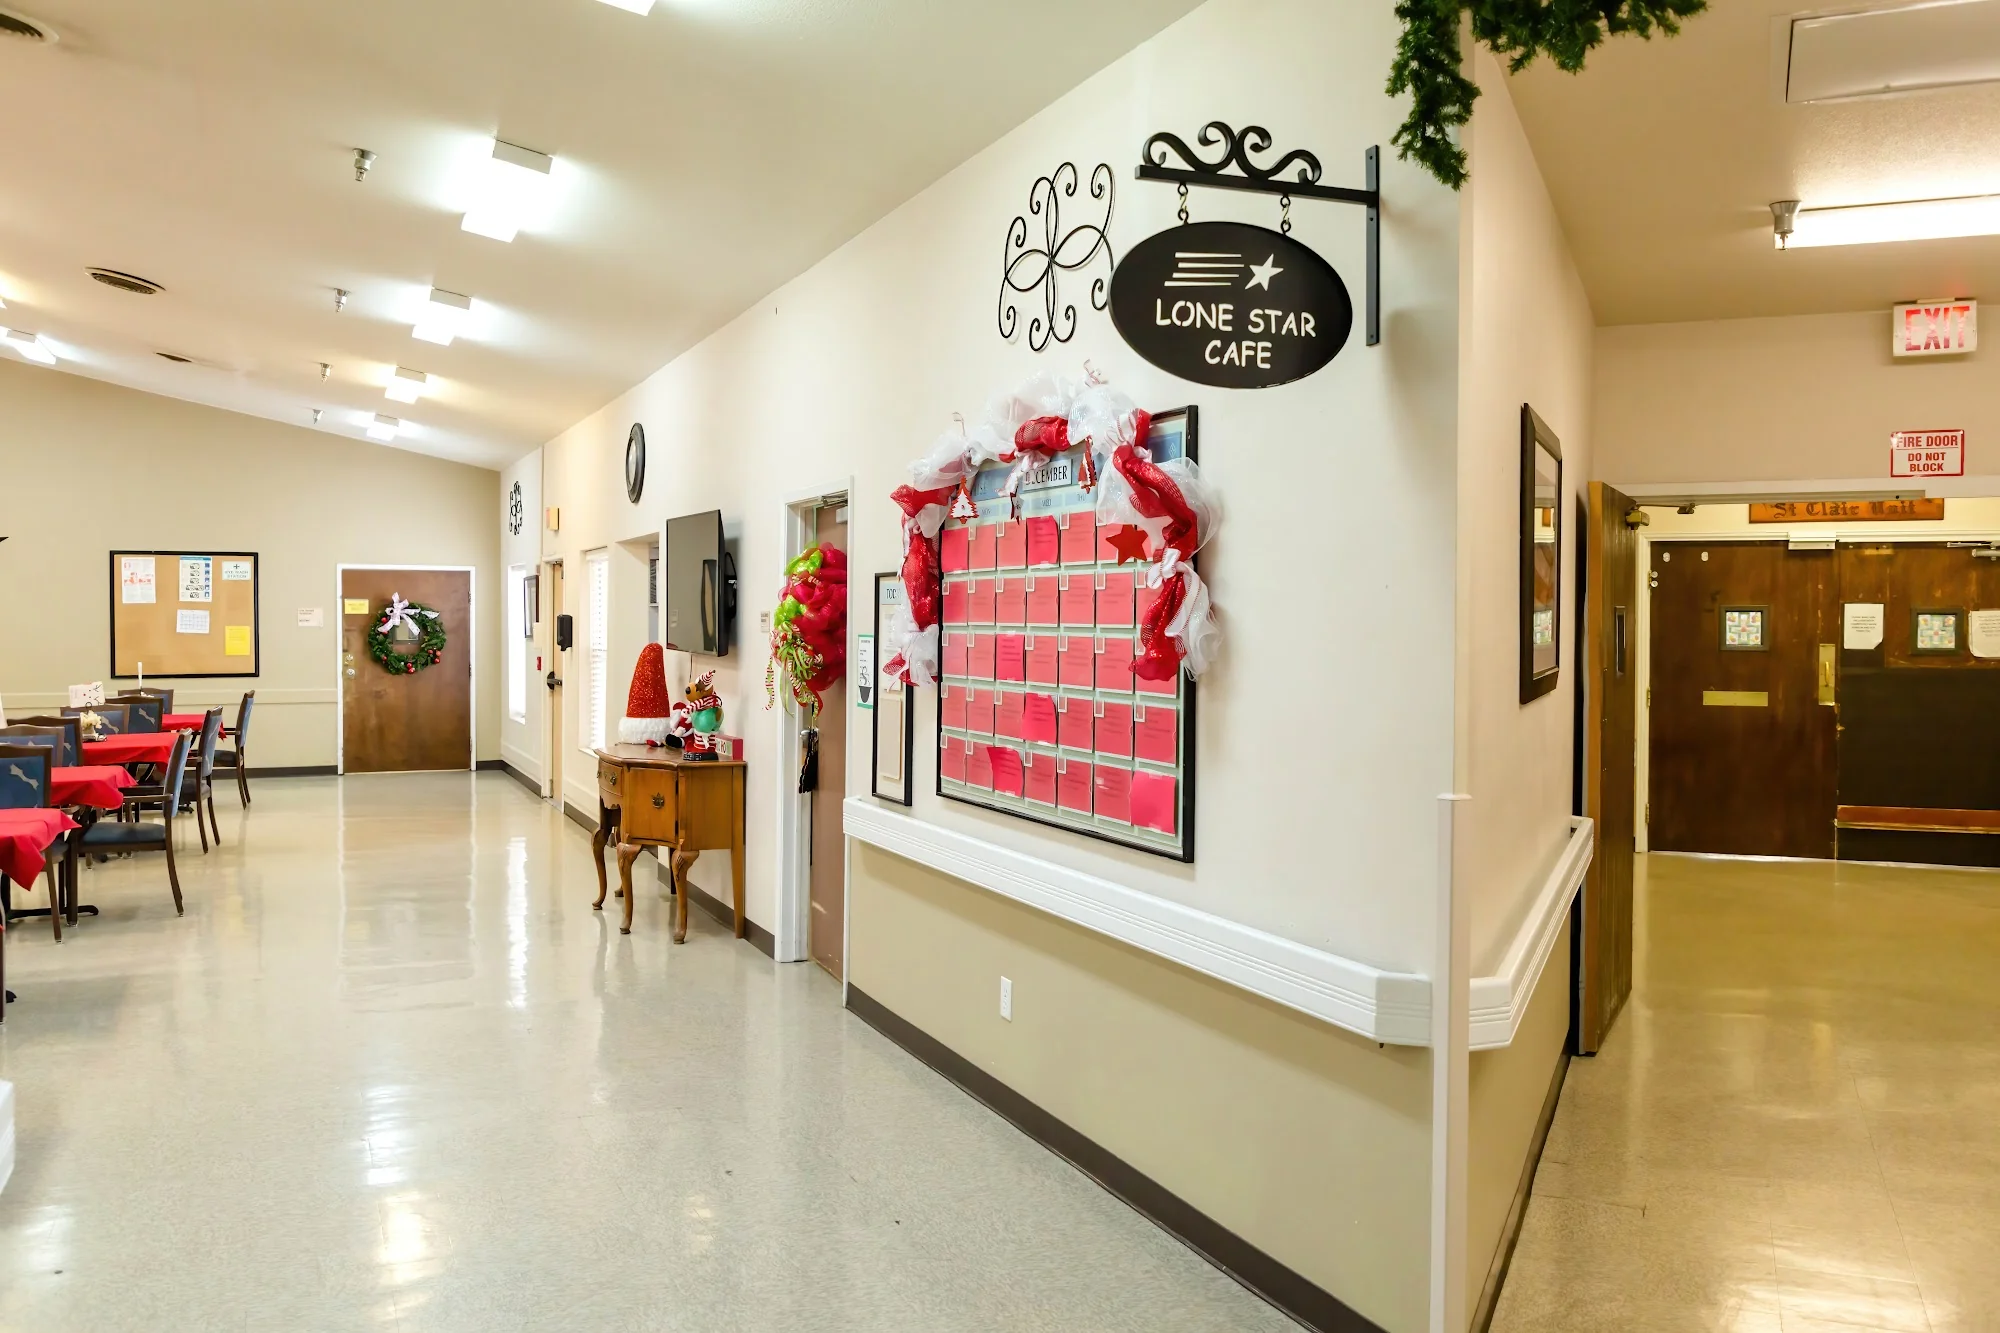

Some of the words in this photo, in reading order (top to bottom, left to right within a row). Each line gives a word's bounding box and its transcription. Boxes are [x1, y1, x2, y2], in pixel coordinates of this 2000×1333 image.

[1156, 298, 1234, 331] LONE
[1247, 308, 1316, 337] STAR
[1905, 306, 1970, 351] EXIT
[1204, 340, 1272, 369] CAFE
[1897, 436, 1922, 448] FIRE
[1926, 435, 1958, 447] DOOR
[1908, 453, 1922, 462] DO
[1925, 452, 1946, 461] NOT
[1909, 463, 1944, 472] BLOCK
[1773, 502, 1797, 519] St
[1806, 501, 1859, 516] Clair
[1869, 500, 1916, 515] Unit
